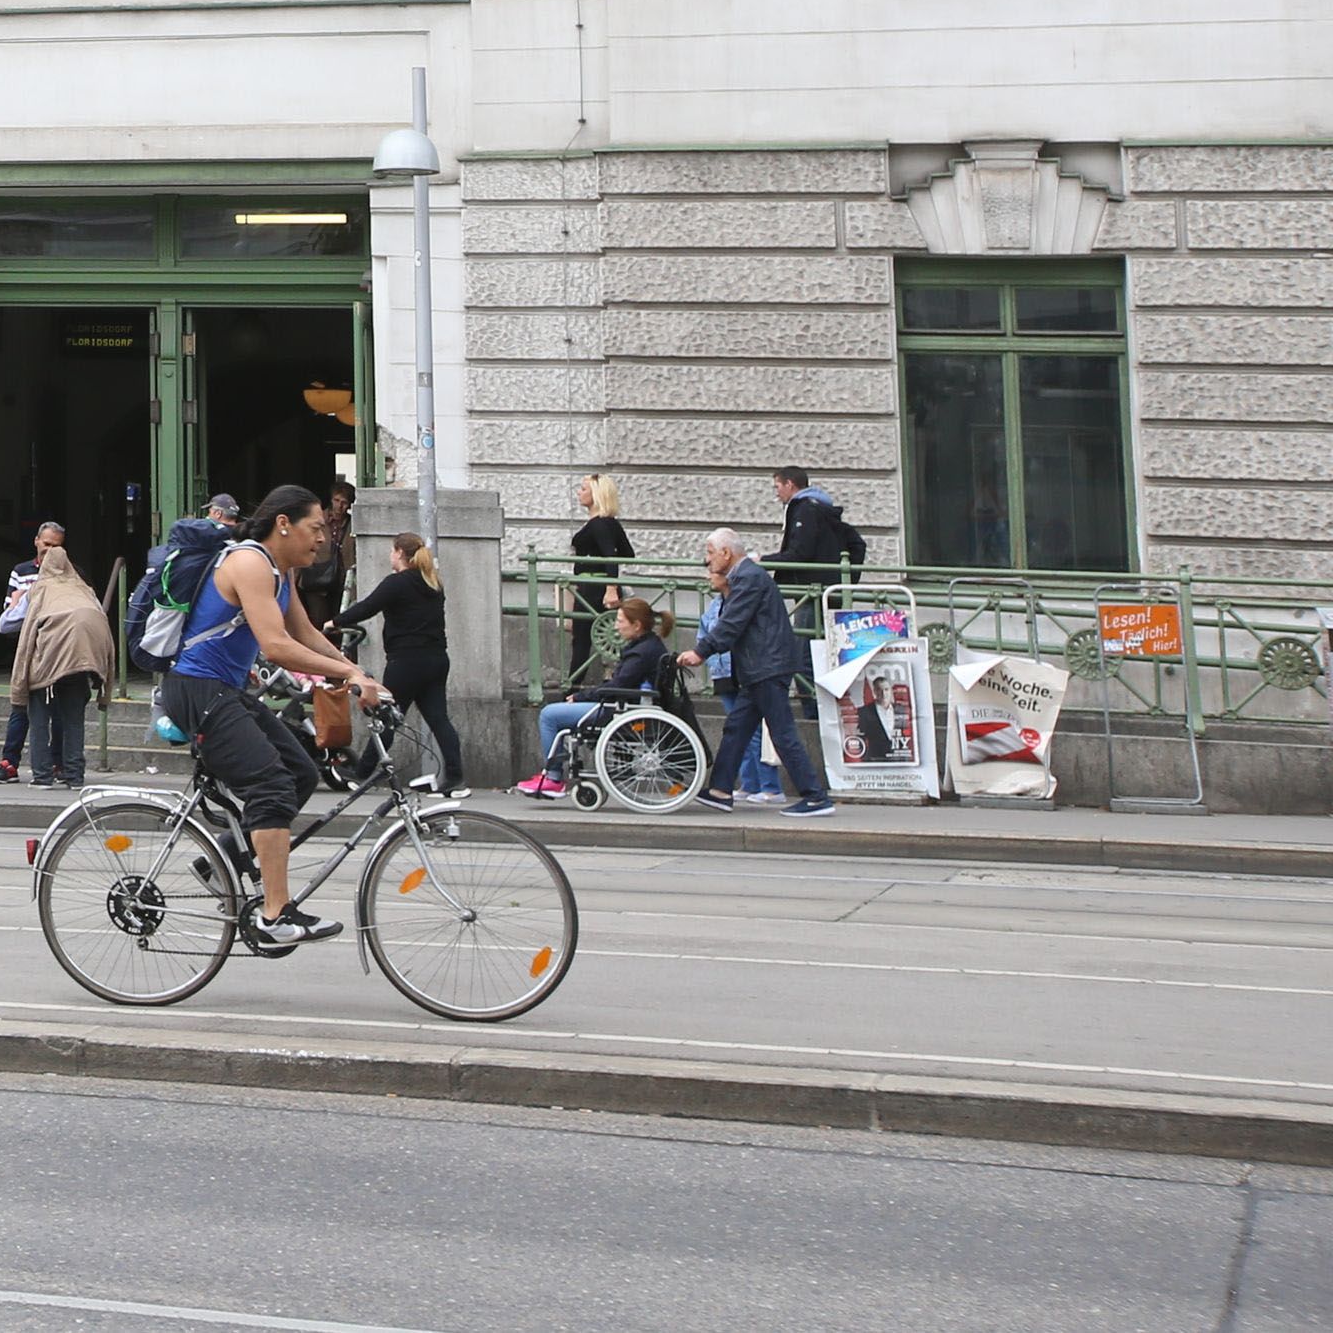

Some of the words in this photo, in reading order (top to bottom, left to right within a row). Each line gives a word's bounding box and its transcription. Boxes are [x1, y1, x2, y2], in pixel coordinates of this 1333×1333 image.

[1103, 606, 1152, 629] Lesen!
[879, 646, 919, 654] AGAZIN
[1153, 637, 1178, 652] Hier!
[978, 677, 1009, 695] eine
[1000, 670, 1054, 700] Woche.
